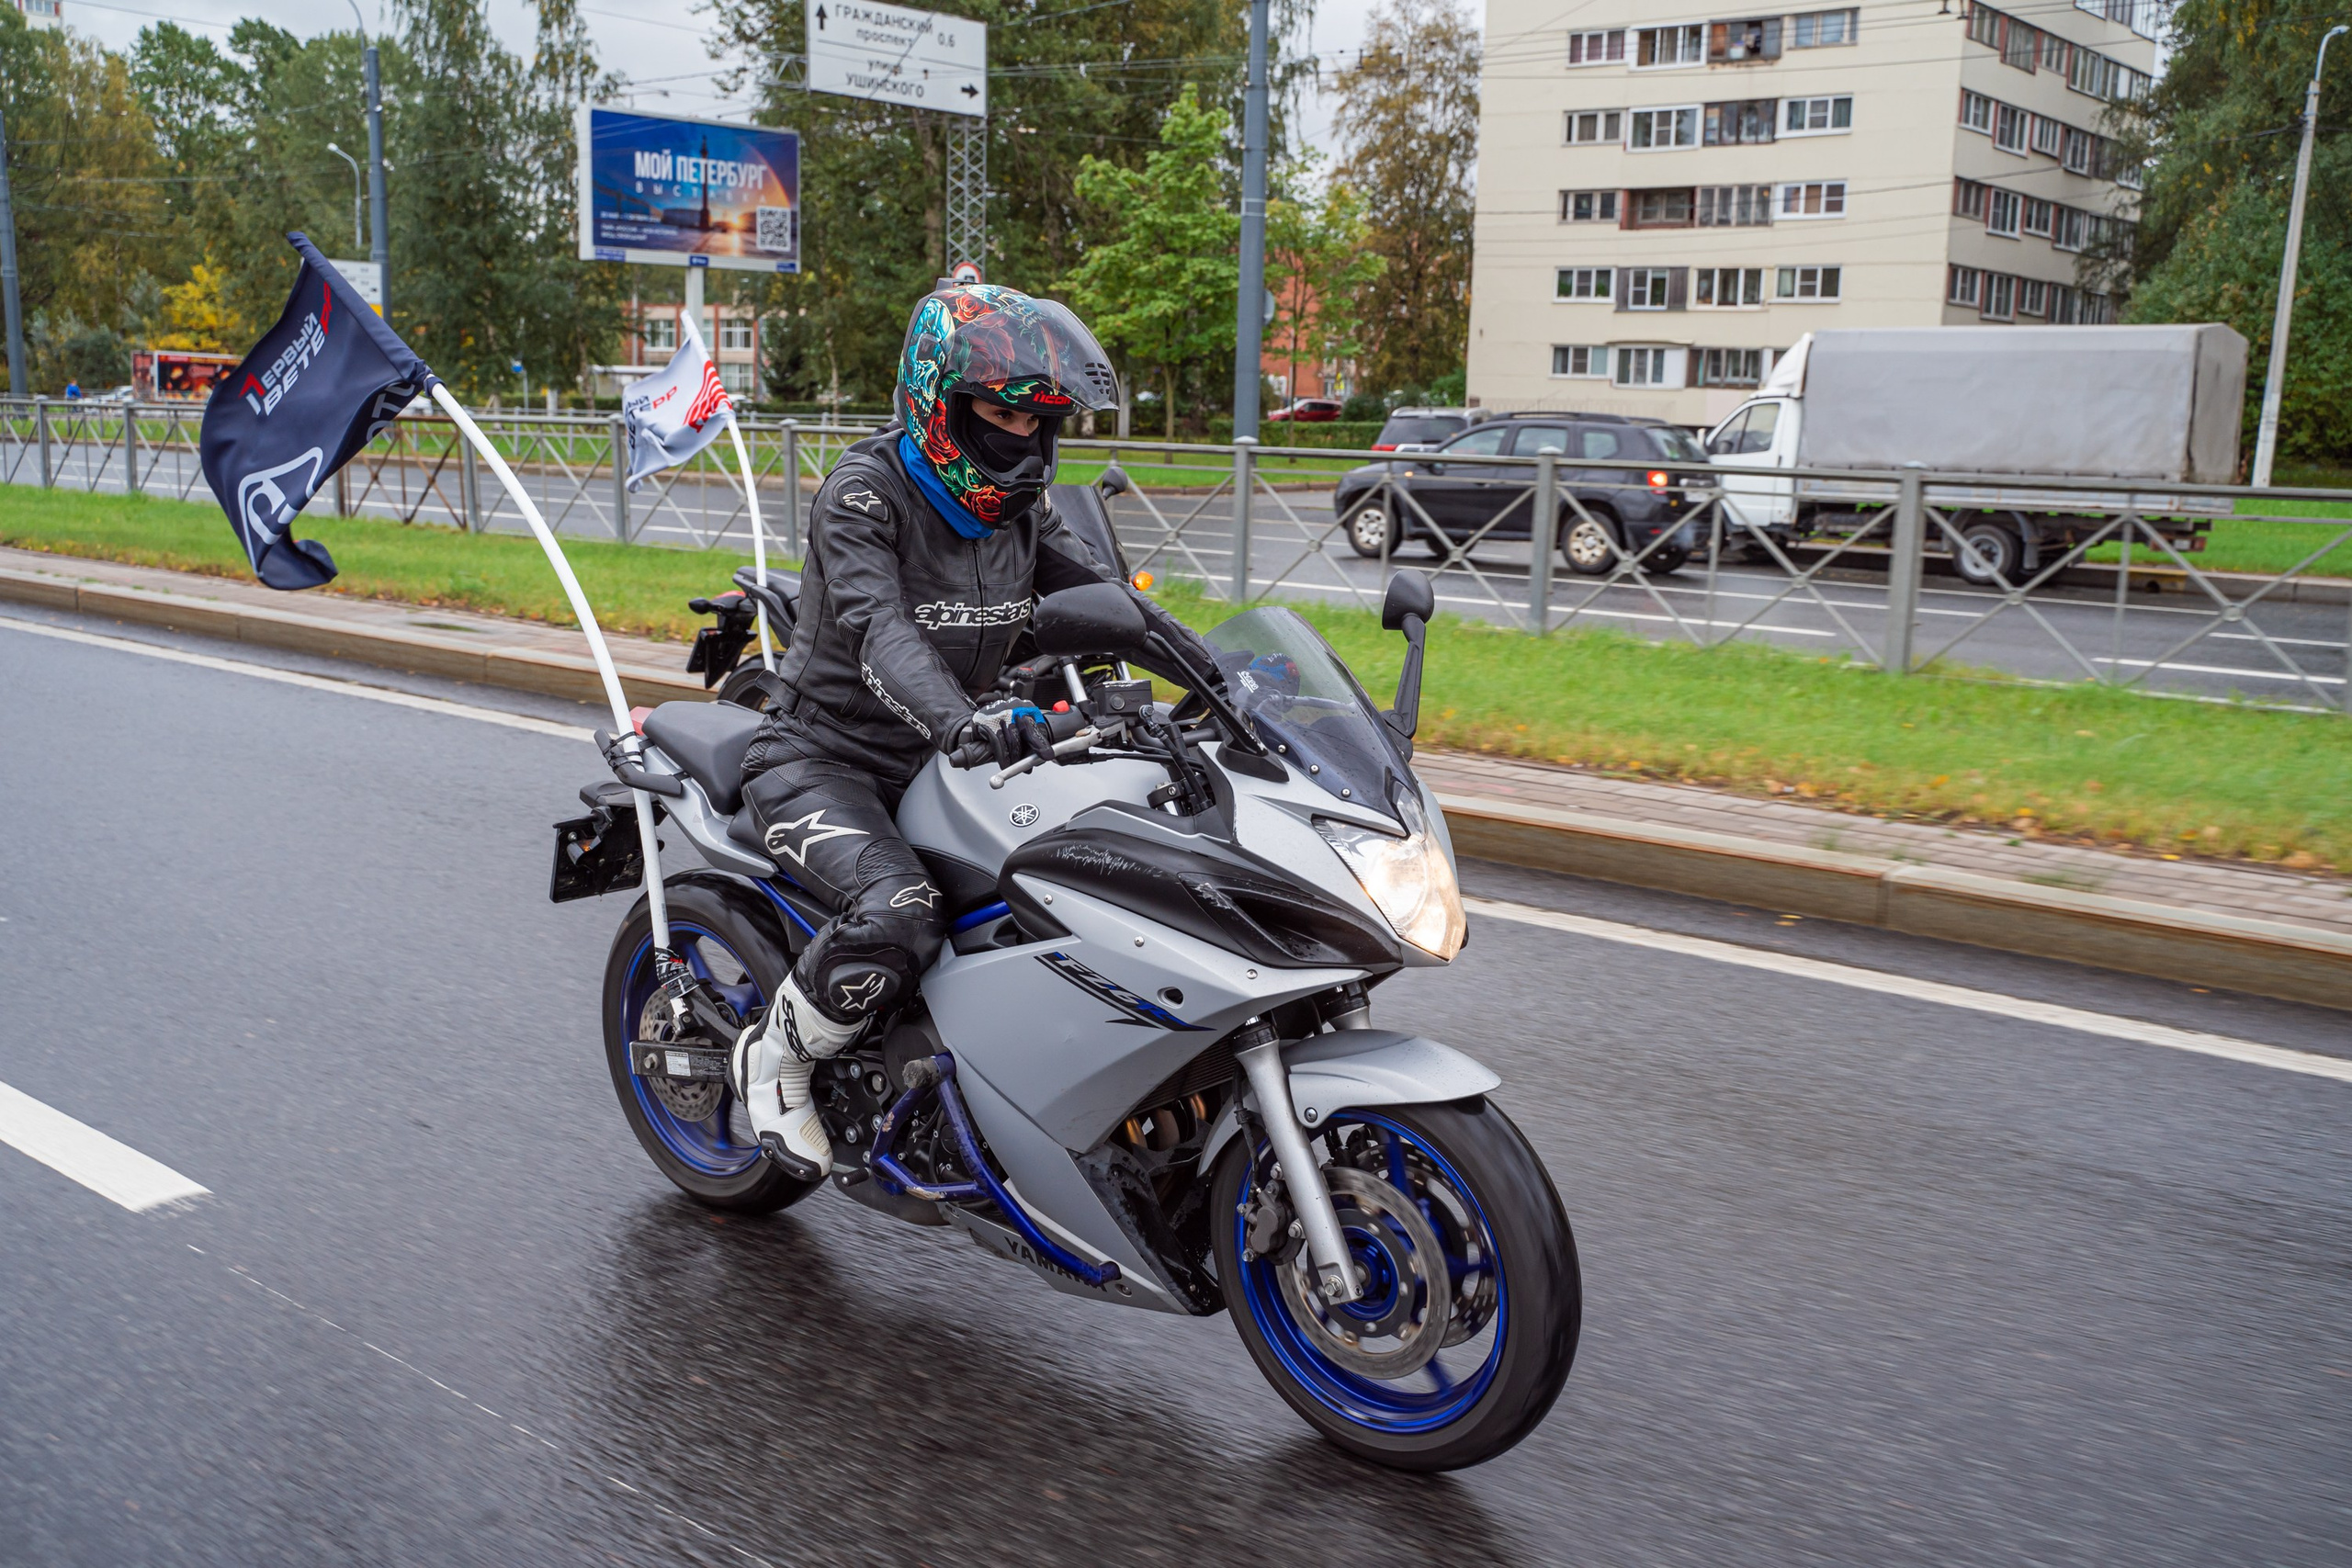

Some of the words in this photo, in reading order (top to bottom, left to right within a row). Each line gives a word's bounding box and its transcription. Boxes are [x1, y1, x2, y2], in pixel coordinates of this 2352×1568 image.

[835, 4, 933, 34] ГРАЖДАНСКИЙ
[856, 28, 913, 47] проспект
[846, 73, 924, 98] УШИНСКОГО
[634, 149, 673, 182] МОЙ
[676, 155, 768, 190] ПЕТЕРБУРГ
[914, 597, 1032, 631] alpinestars
[861, 661, 932, 740] alpinestars
